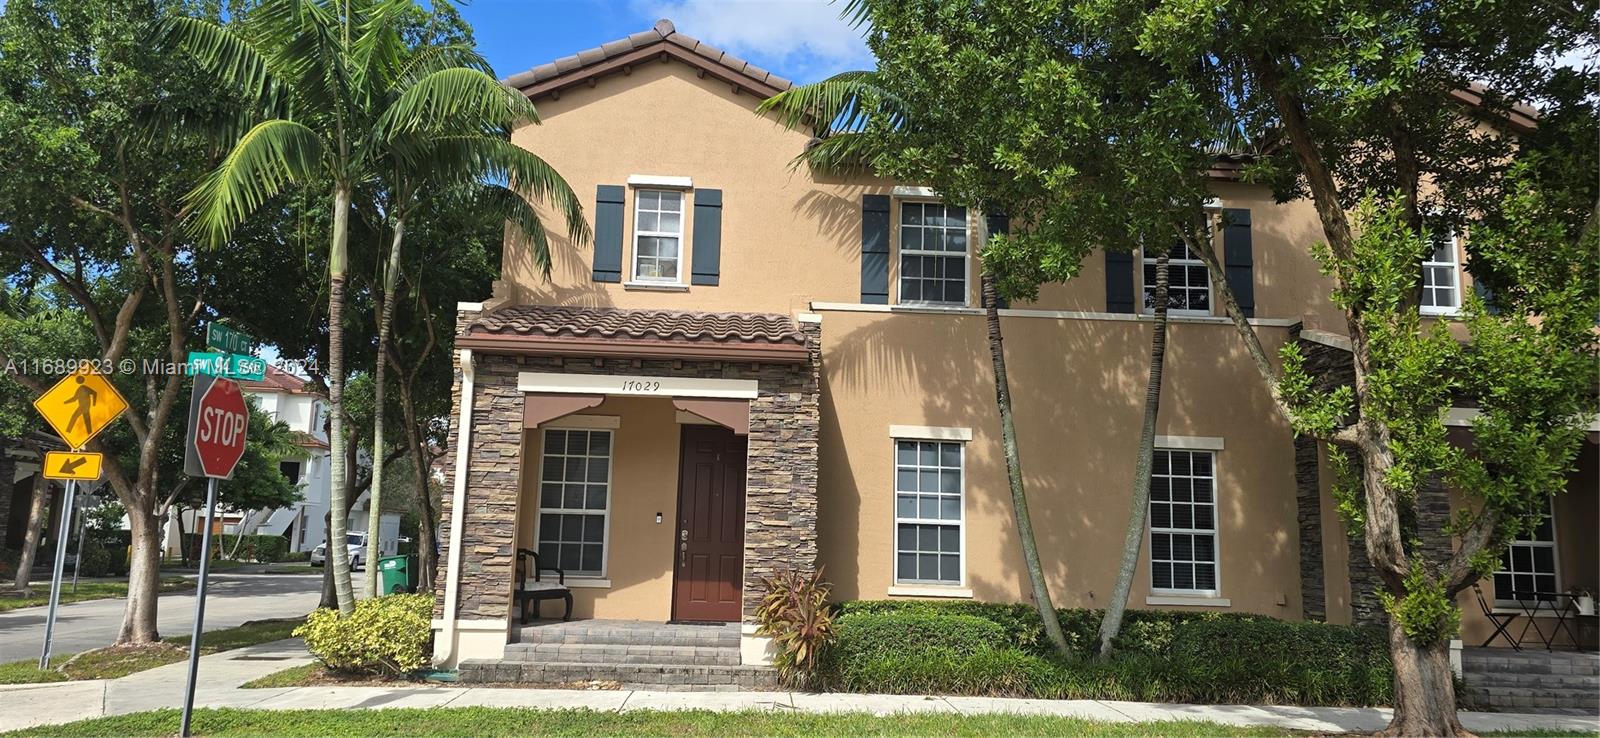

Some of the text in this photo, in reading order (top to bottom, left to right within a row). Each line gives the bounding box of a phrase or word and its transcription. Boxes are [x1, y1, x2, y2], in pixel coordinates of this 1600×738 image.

[211, 329, 248, 352] SW 170 CT
[193, 359, 208, 370] SW
[622, 380, 660, 391] 17029
[200, 406, 244, 447] STOP
